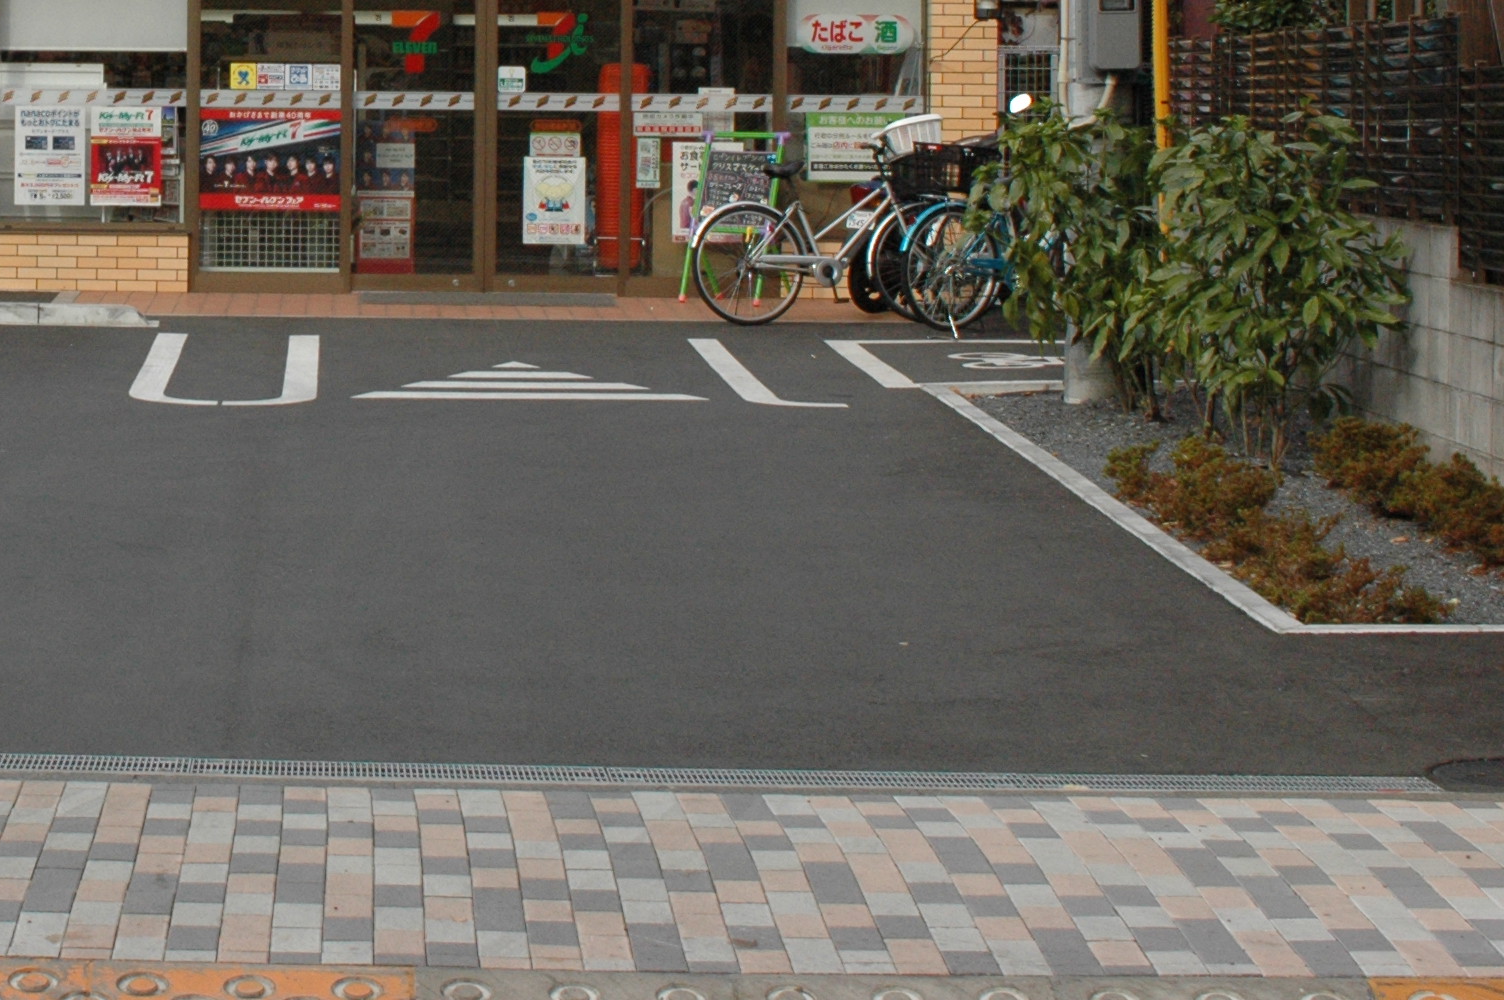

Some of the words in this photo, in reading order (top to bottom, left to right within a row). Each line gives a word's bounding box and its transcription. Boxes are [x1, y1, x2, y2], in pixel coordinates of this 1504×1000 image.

[811, 20, 864, 43] たばこ
[874, 20, 898, 43] 酒
